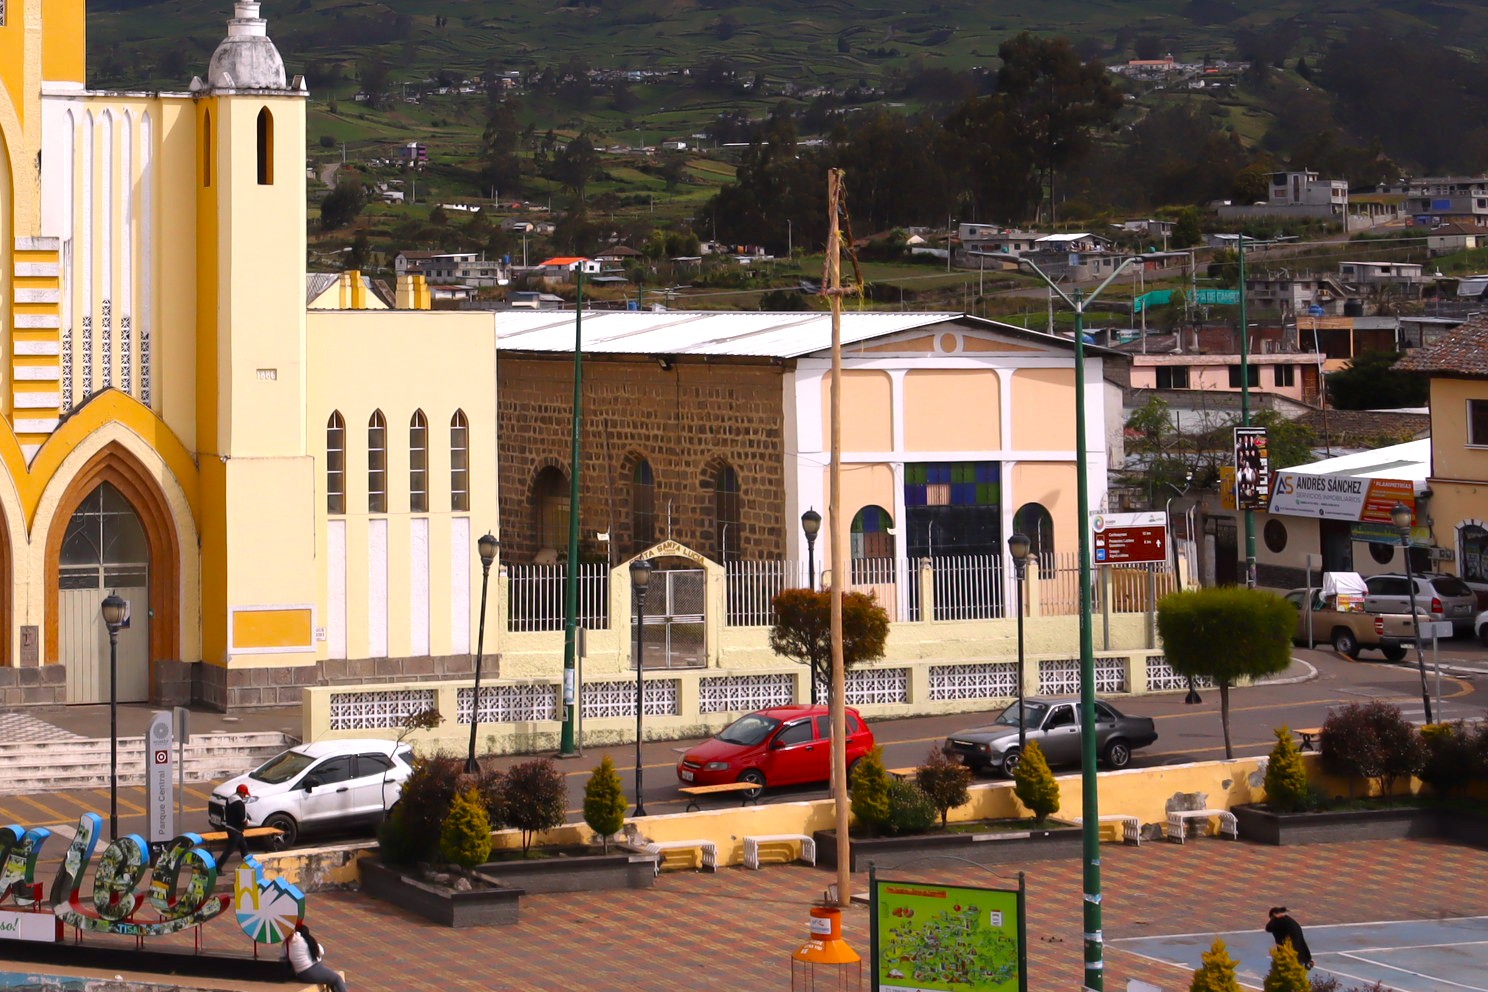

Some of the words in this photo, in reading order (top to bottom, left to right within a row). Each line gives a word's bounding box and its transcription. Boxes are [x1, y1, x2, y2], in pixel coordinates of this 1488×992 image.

[1276, 476, 1294, 495] AS
[1296, 476, 1326, 491] ANDRÉS
[1327, 477, 1362, 494] SÁNCHEZ
[656, 541, 681, 552] SANTA
[683, 548, 704, 564] LUCIA
[158, 770, 166, 802] Central
[159, 806, 167, 835] Parque
